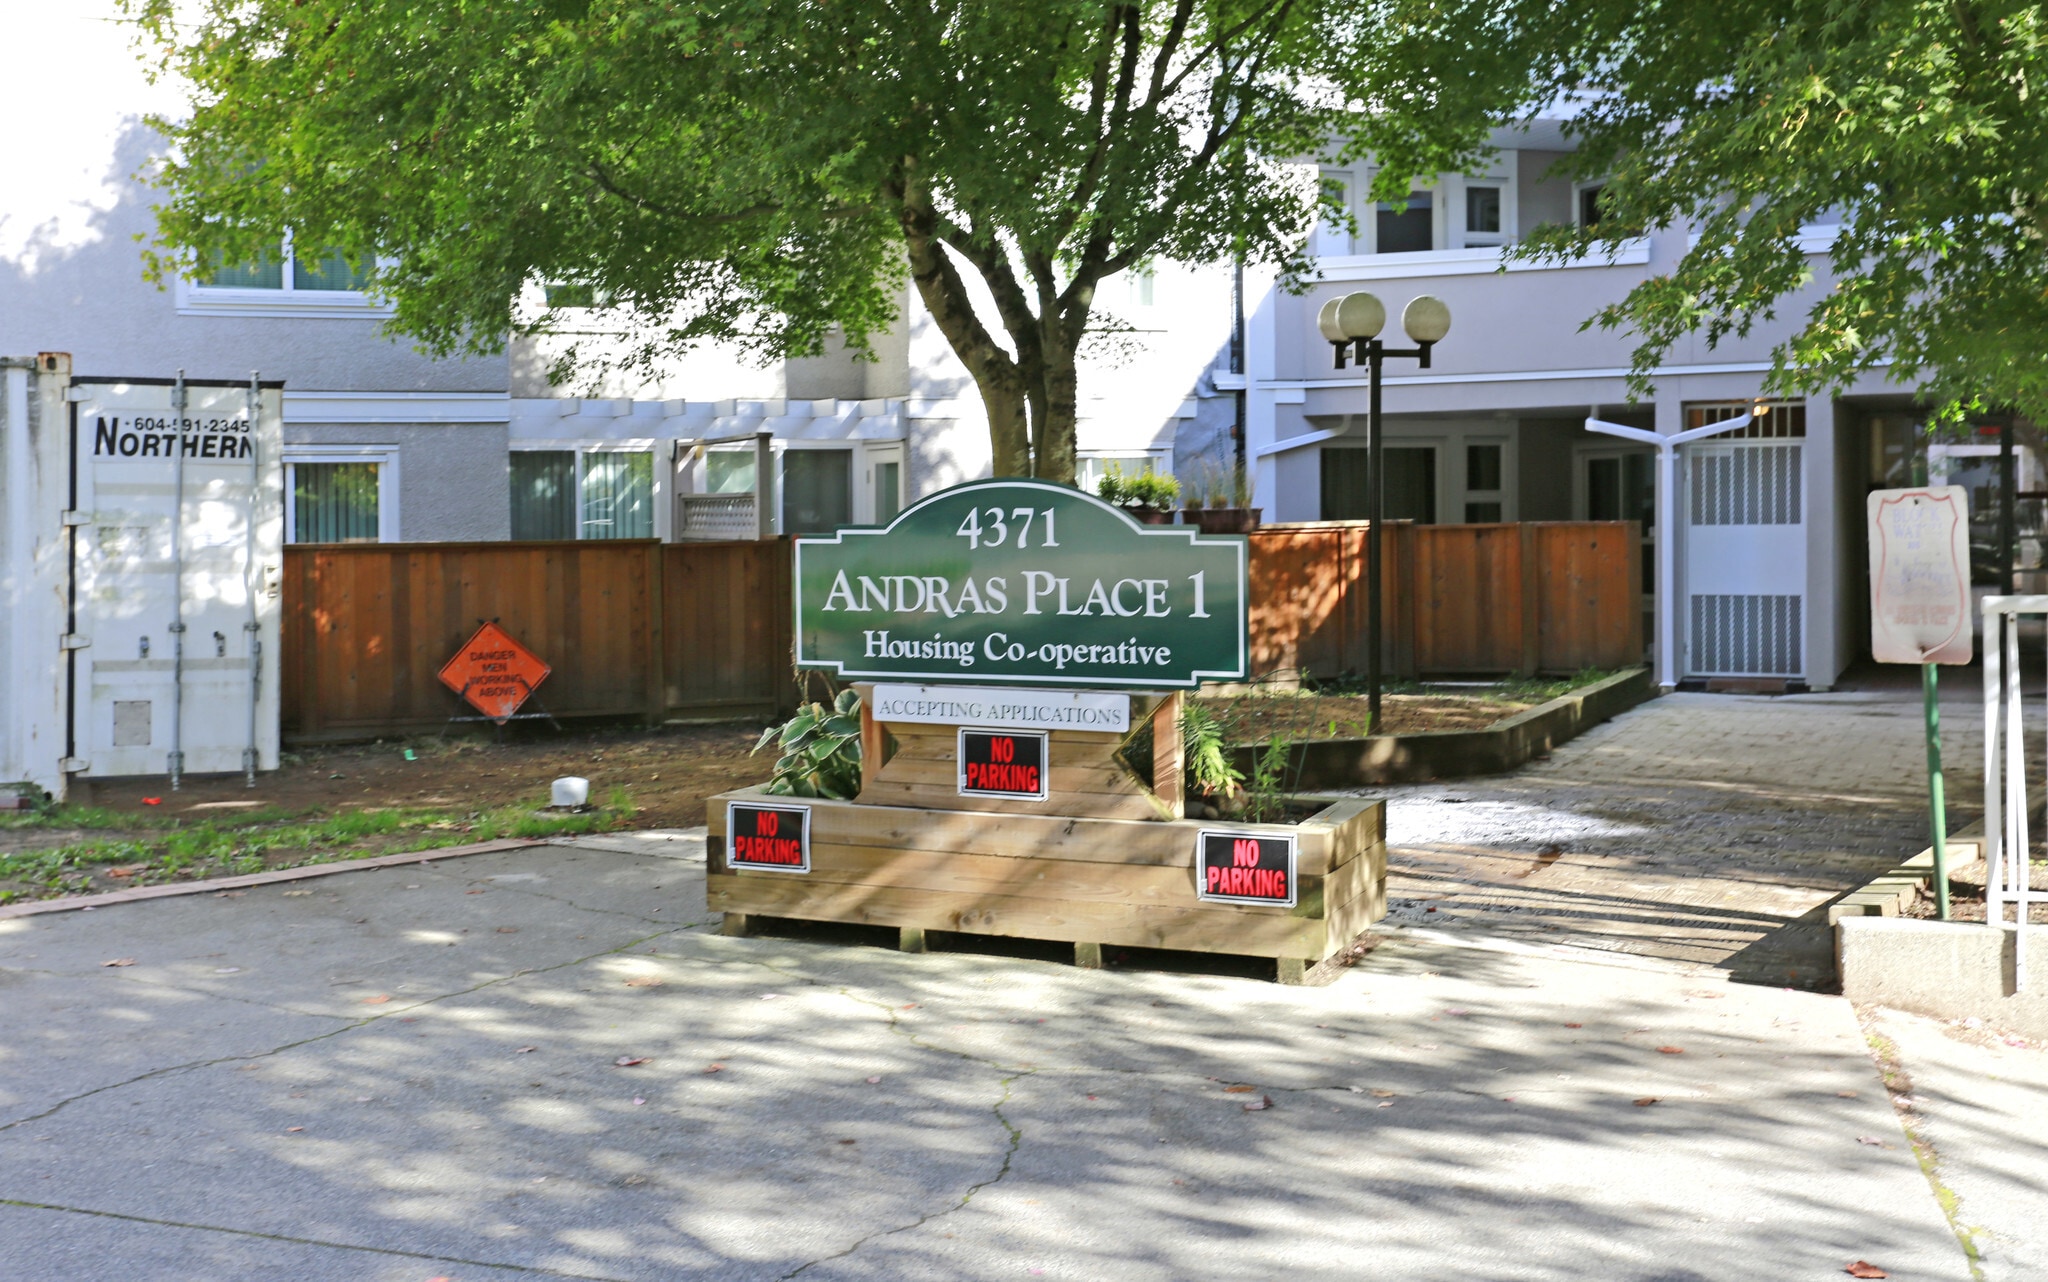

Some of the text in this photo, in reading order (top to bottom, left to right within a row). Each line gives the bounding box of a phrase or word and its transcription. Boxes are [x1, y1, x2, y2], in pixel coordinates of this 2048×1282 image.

[94, 417, 253, 459] NORTHERN
[956, 507, 1060, 549] 4371
[822, 569, 1211, 618] ANDRAS PLACE 1
[469, 650, 516, 661] DANGER
[863, 630, 1171, 669] Housing Co-operative
[470, 674, 522, 685] WORKING
[482, 663, 507, 672] MEN
[479, 686, 517, 697] ABOVE
[879, 700, 1122, 725] ACCEPTING APPLICATIONS
[991, 736, 1014, 763] NO
[967, 762, 1038, 792] PARKING
[757, 811, 778, 837] NO
[735, 835, 800, 864] PARKING
[1234, 839, 1259, 868] NO
[1207, 866, 1286, 898] PARKING
